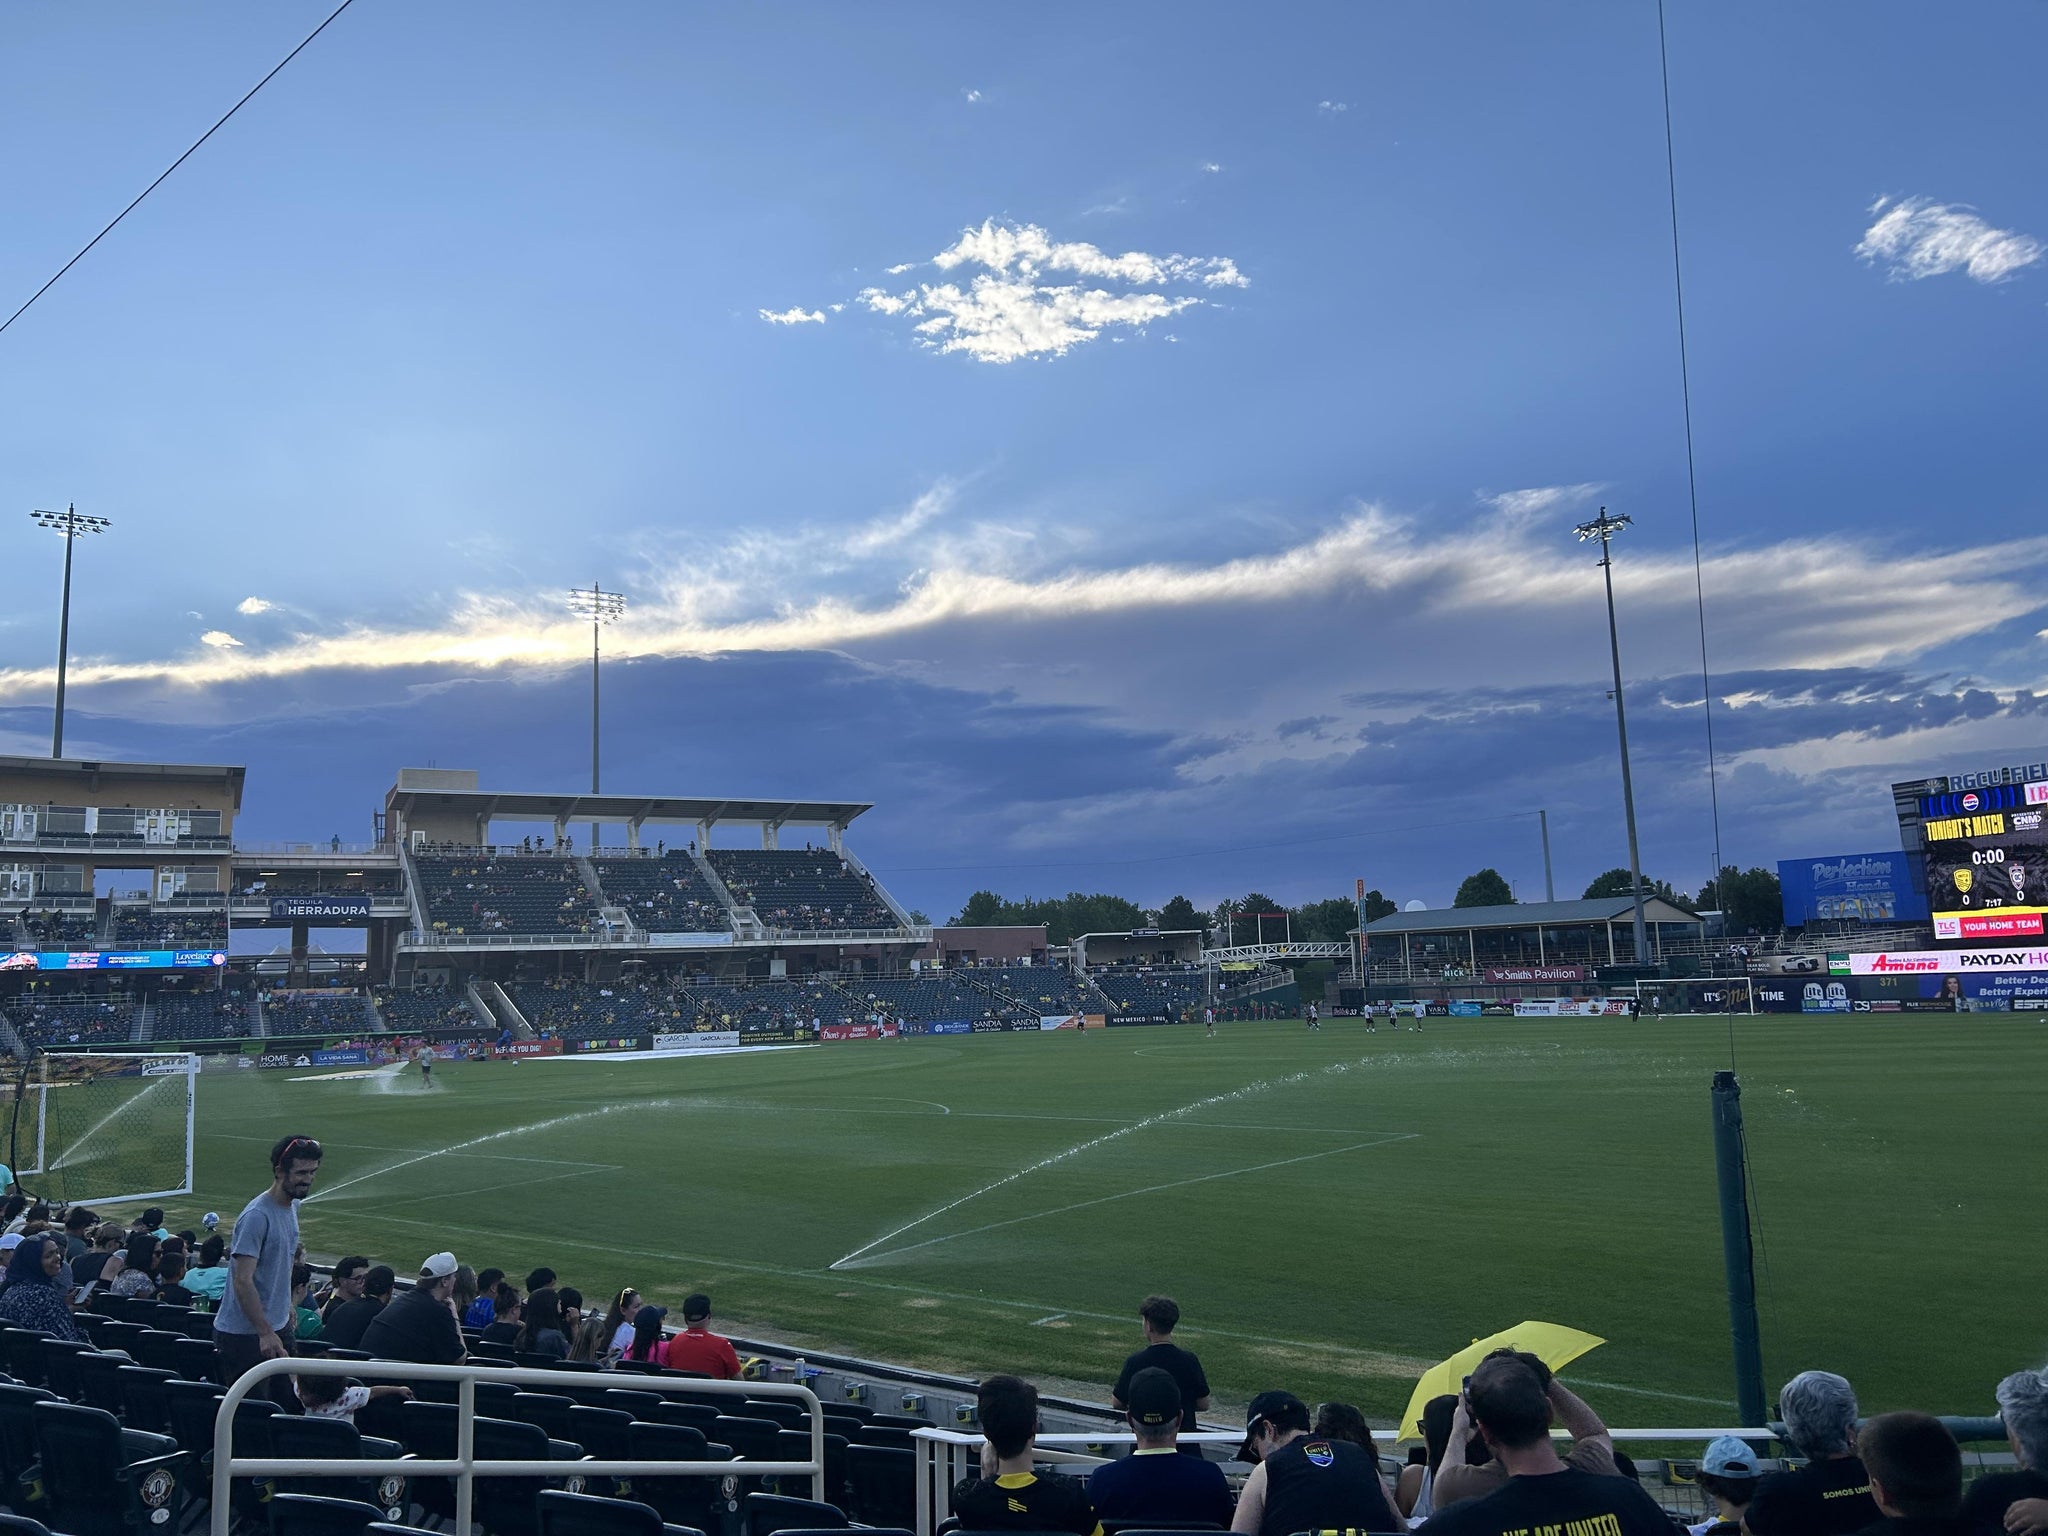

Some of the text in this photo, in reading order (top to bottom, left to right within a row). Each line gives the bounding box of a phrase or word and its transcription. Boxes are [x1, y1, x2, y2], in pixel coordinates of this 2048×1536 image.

[1949, 769, 2001, 792] RGCU
[2013, 815, 2038, 825] CNM
[1926, 814, 2005, 841] TONIGHT'S MATCH
[1972, 849, 2005, 865] 0:00
[1812, 858, 1892, 881] Perfection
[1845, 879, 1891, 892] Honda
[1985, 899, 2002, 907] 7:17
[288, 906, 367, 915] HERRADURA
[1817, 898, 1896, 919] GIANT
[1938, 922, 1956, 930] TLC
[1964, 920, 2040, 931] YOUR HOME TEAM
[175, 952, 212, 960] Lovelace
[1959, 953, 2027, 966] PAYDAY
[1871, 954, 1939, 971] Amana
[1444, 969, 1465, 977] NICK
[1505, 969, 1576, 980] Smith's Pavilion
[1880, 977, 1897, 986] 371
[1995, 977, 2028, 985] Better
[1704, 992, 1720, 1002] IT'S
[1760, 991, 1785, 1001] TIME
[1805, 987, 1821, 998] Lite
[1827, 987, 1844, 998] Lite
[1980, 988, 2012, 996] Better
[972, 1020, 1002, 1028] SANDIA
[1011, 1018, 1039, 1026] SANDIA
[518, 1045, 529, 1053] YOU
[577, 1039, 638, 1049] MEOW WOLF
[261, 1054, 289, 1063] HOME
[1823, 1485, 1871, 1499] SOMOS UNI
